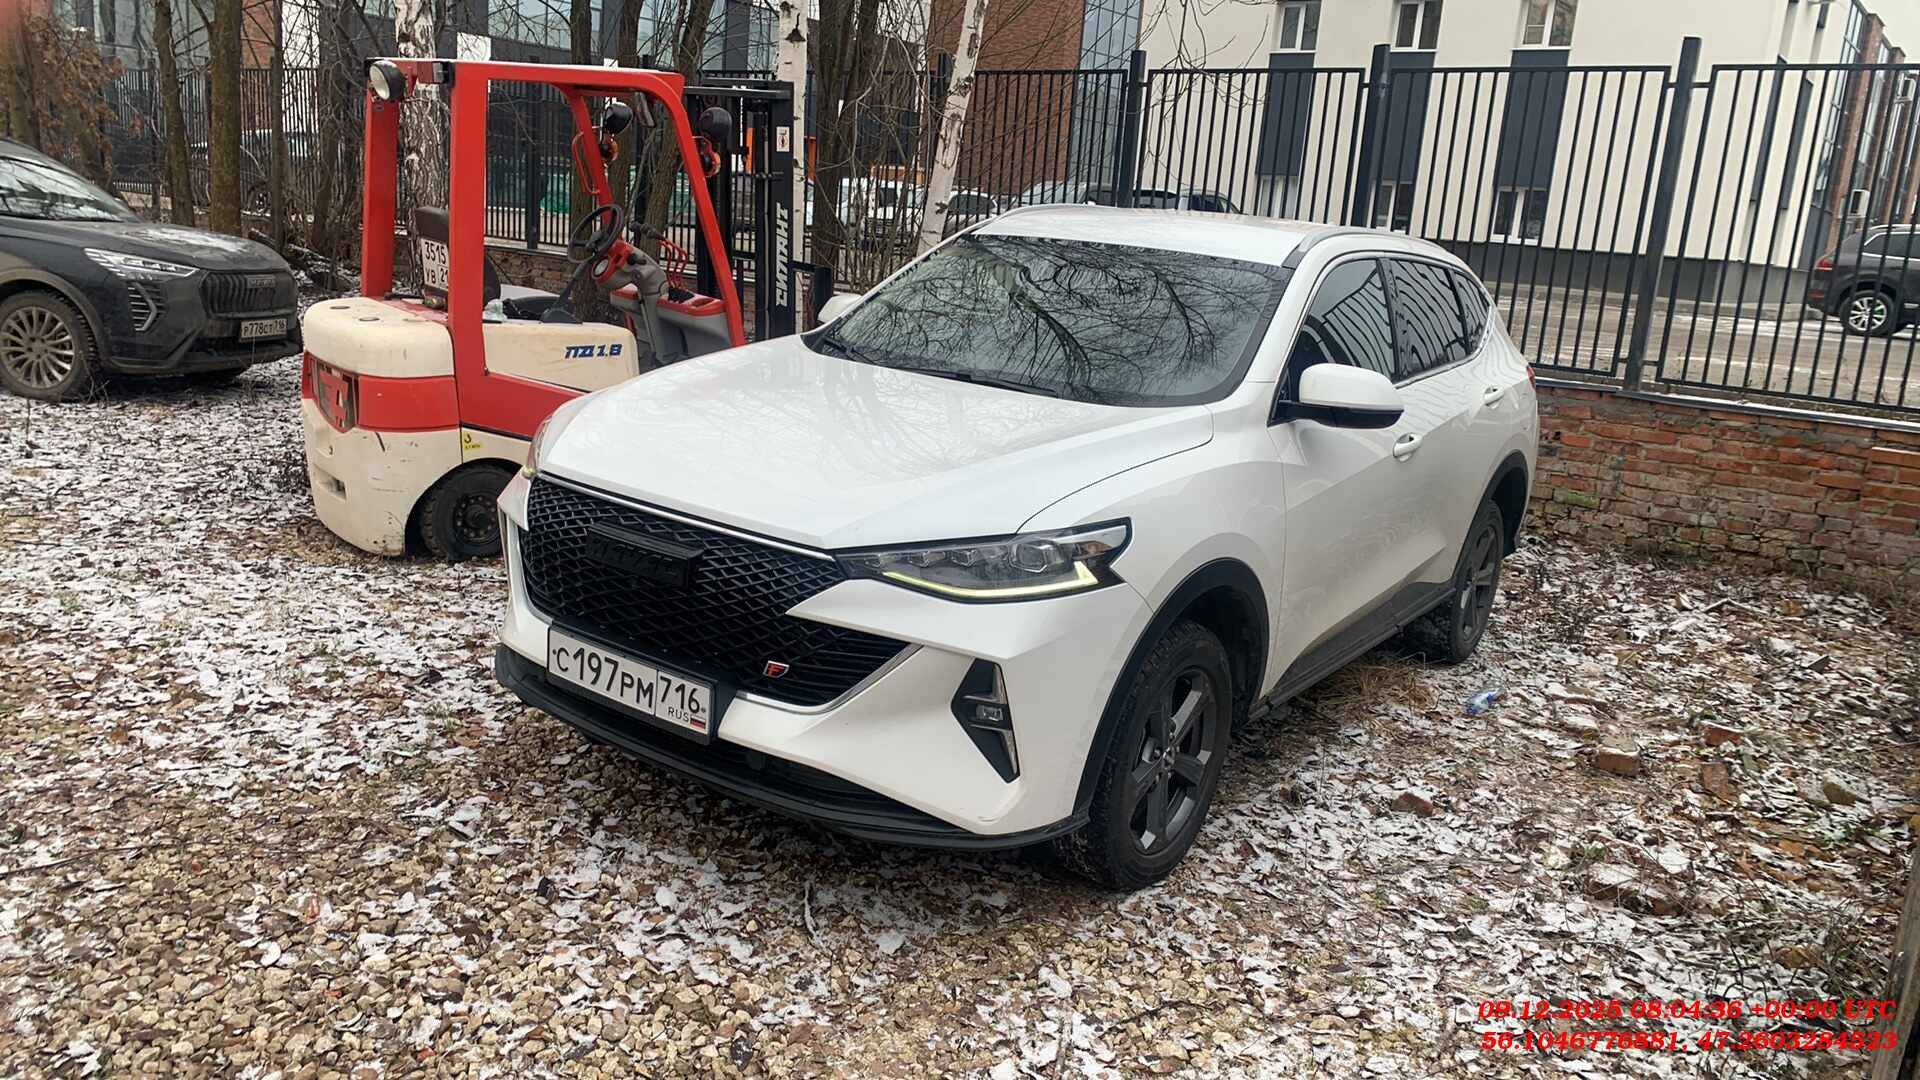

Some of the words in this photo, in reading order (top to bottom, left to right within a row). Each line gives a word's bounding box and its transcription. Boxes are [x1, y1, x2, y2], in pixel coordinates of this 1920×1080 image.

[425, 241, 446, 265] 3515
[775, 201, 789, 307] СИЛАНТ
[425, 267, 436, 284] УВ
[596, 343, 623, 357] 1.8
[556, 647, 655, 708] С197РМ
[659, 675, 701, 714] 716
[667, 706, 690, 723] RUS
